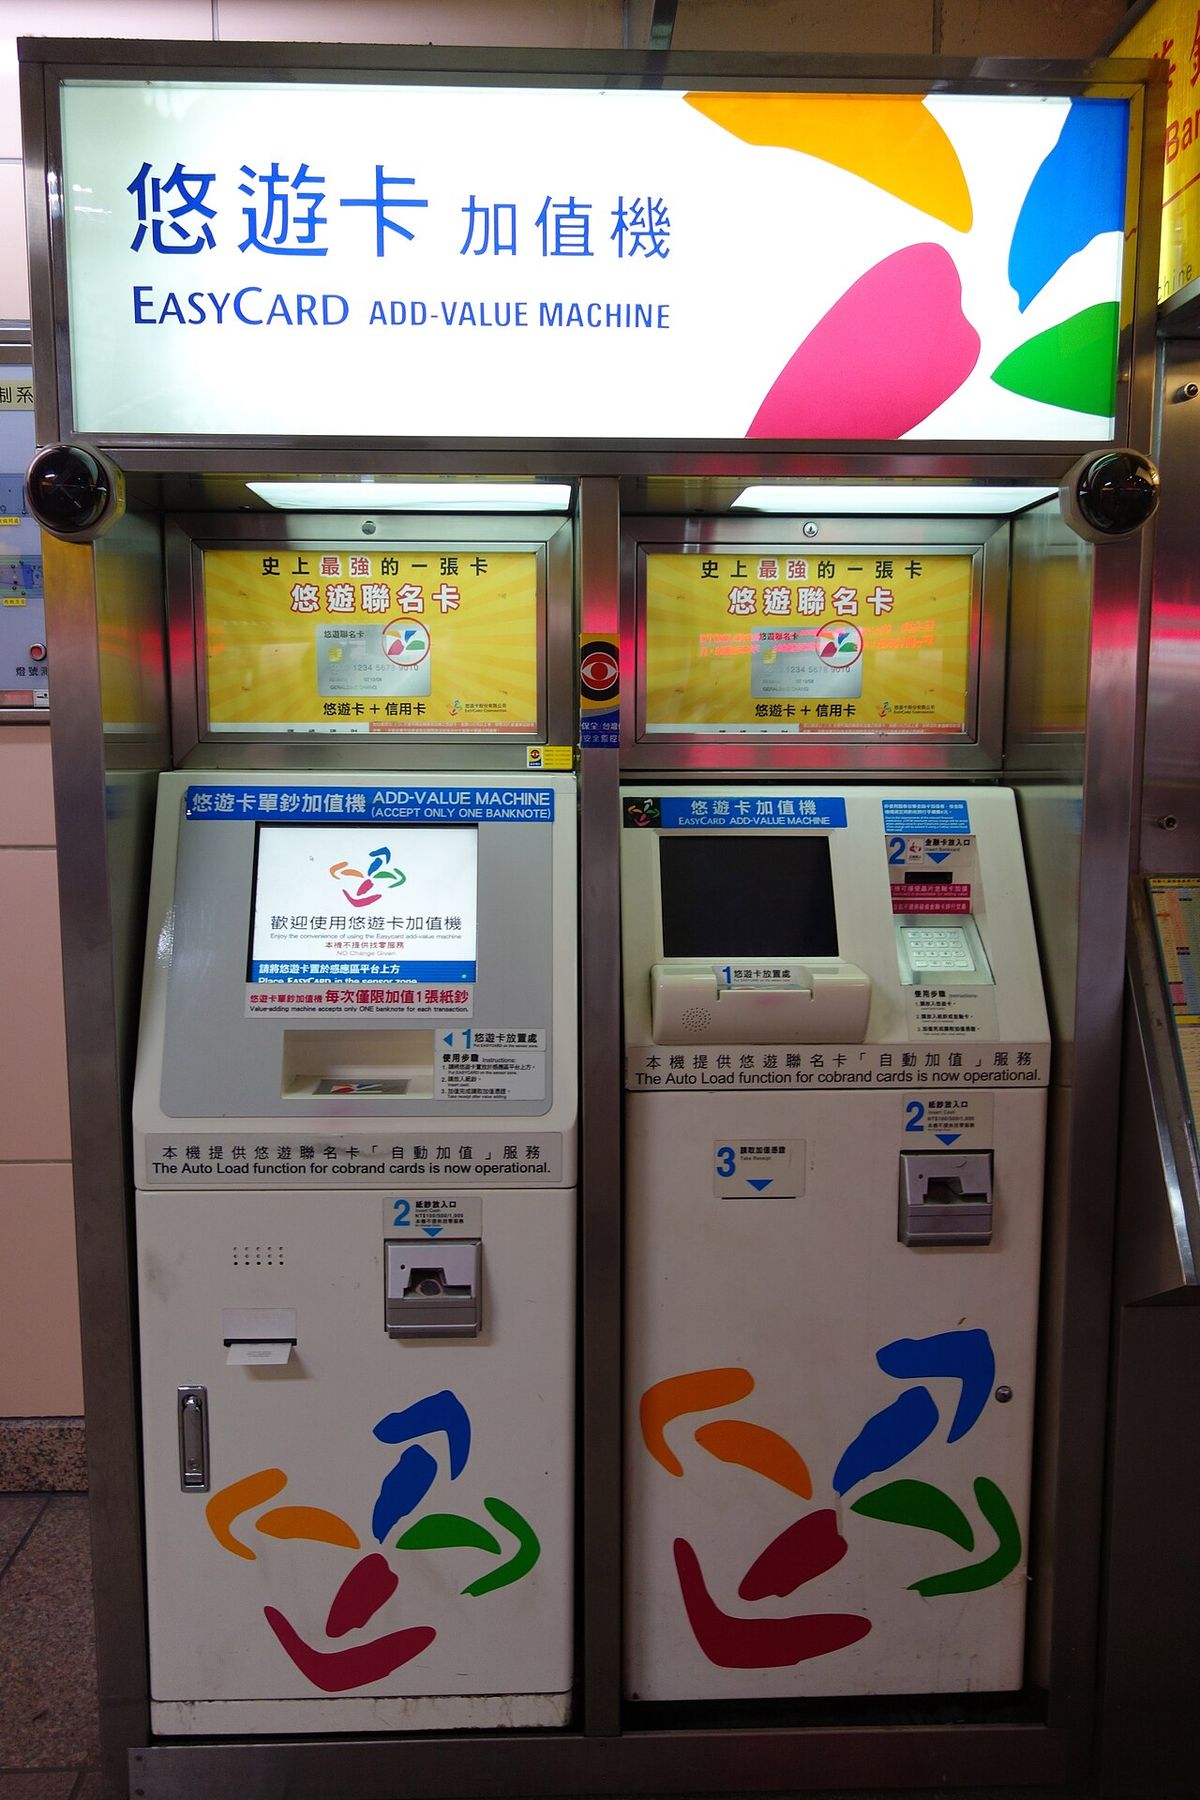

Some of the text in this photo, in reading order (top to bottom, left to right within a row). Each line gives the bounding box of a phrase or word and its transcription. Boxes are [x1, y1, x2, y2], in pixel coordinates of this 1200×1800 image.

[126, 161, 671, 259] 悠遊卡 加值機
[132, 285, 671, 329] EASYCARD ADD-VALUE MACHINE
[261, 555, 489, 577] 史上最強的一張卡
[701, 559, 923, 579] 史上最強的一張卡
[289, 583, 462, 614] 悠遊聯名卡
[727, 586, 895, 616] 悠遊聯名卡
[353, 663, 373, 672] 1234
[192, 793, 366, 813] 悠遊卡單鈔加值機
[372, 791, 550, 805] ADD-VALUE MACHINE
[690, 799, 817, 816] 悠遊卡加值機
[371, 807, 551, 819] (ACCEPT ONLY ONE BANKNOTE)
[678, 816, 830, 825] EASYCARD ADD-VALUE MACHINE
[888, 837, 906, 864] 2
[270, 916, 462, 931] 歡迎使用悠遊卡加值機
[722, 966, 731, 984] 1
[734, 969, 791, 979] 悠遊卡放置處
[325, 989, 469, 1004] 每次僅限加值1張紙鈔
[462, 1028, 471, 1049] 1
[474, 1033, 538, 1043] 悠遊卡放置處
[635, 1069, 1041, 1085] The Auto Load function for cobrand cards is now operational.
[905, 1101, 925, 1132] 2
[152, 1163, 551, 1174] The Auto Load function for cobrand cards is now operational.
[716, 1146, 736, 1178] 3
[393, 1199, 411, 1227] 2
